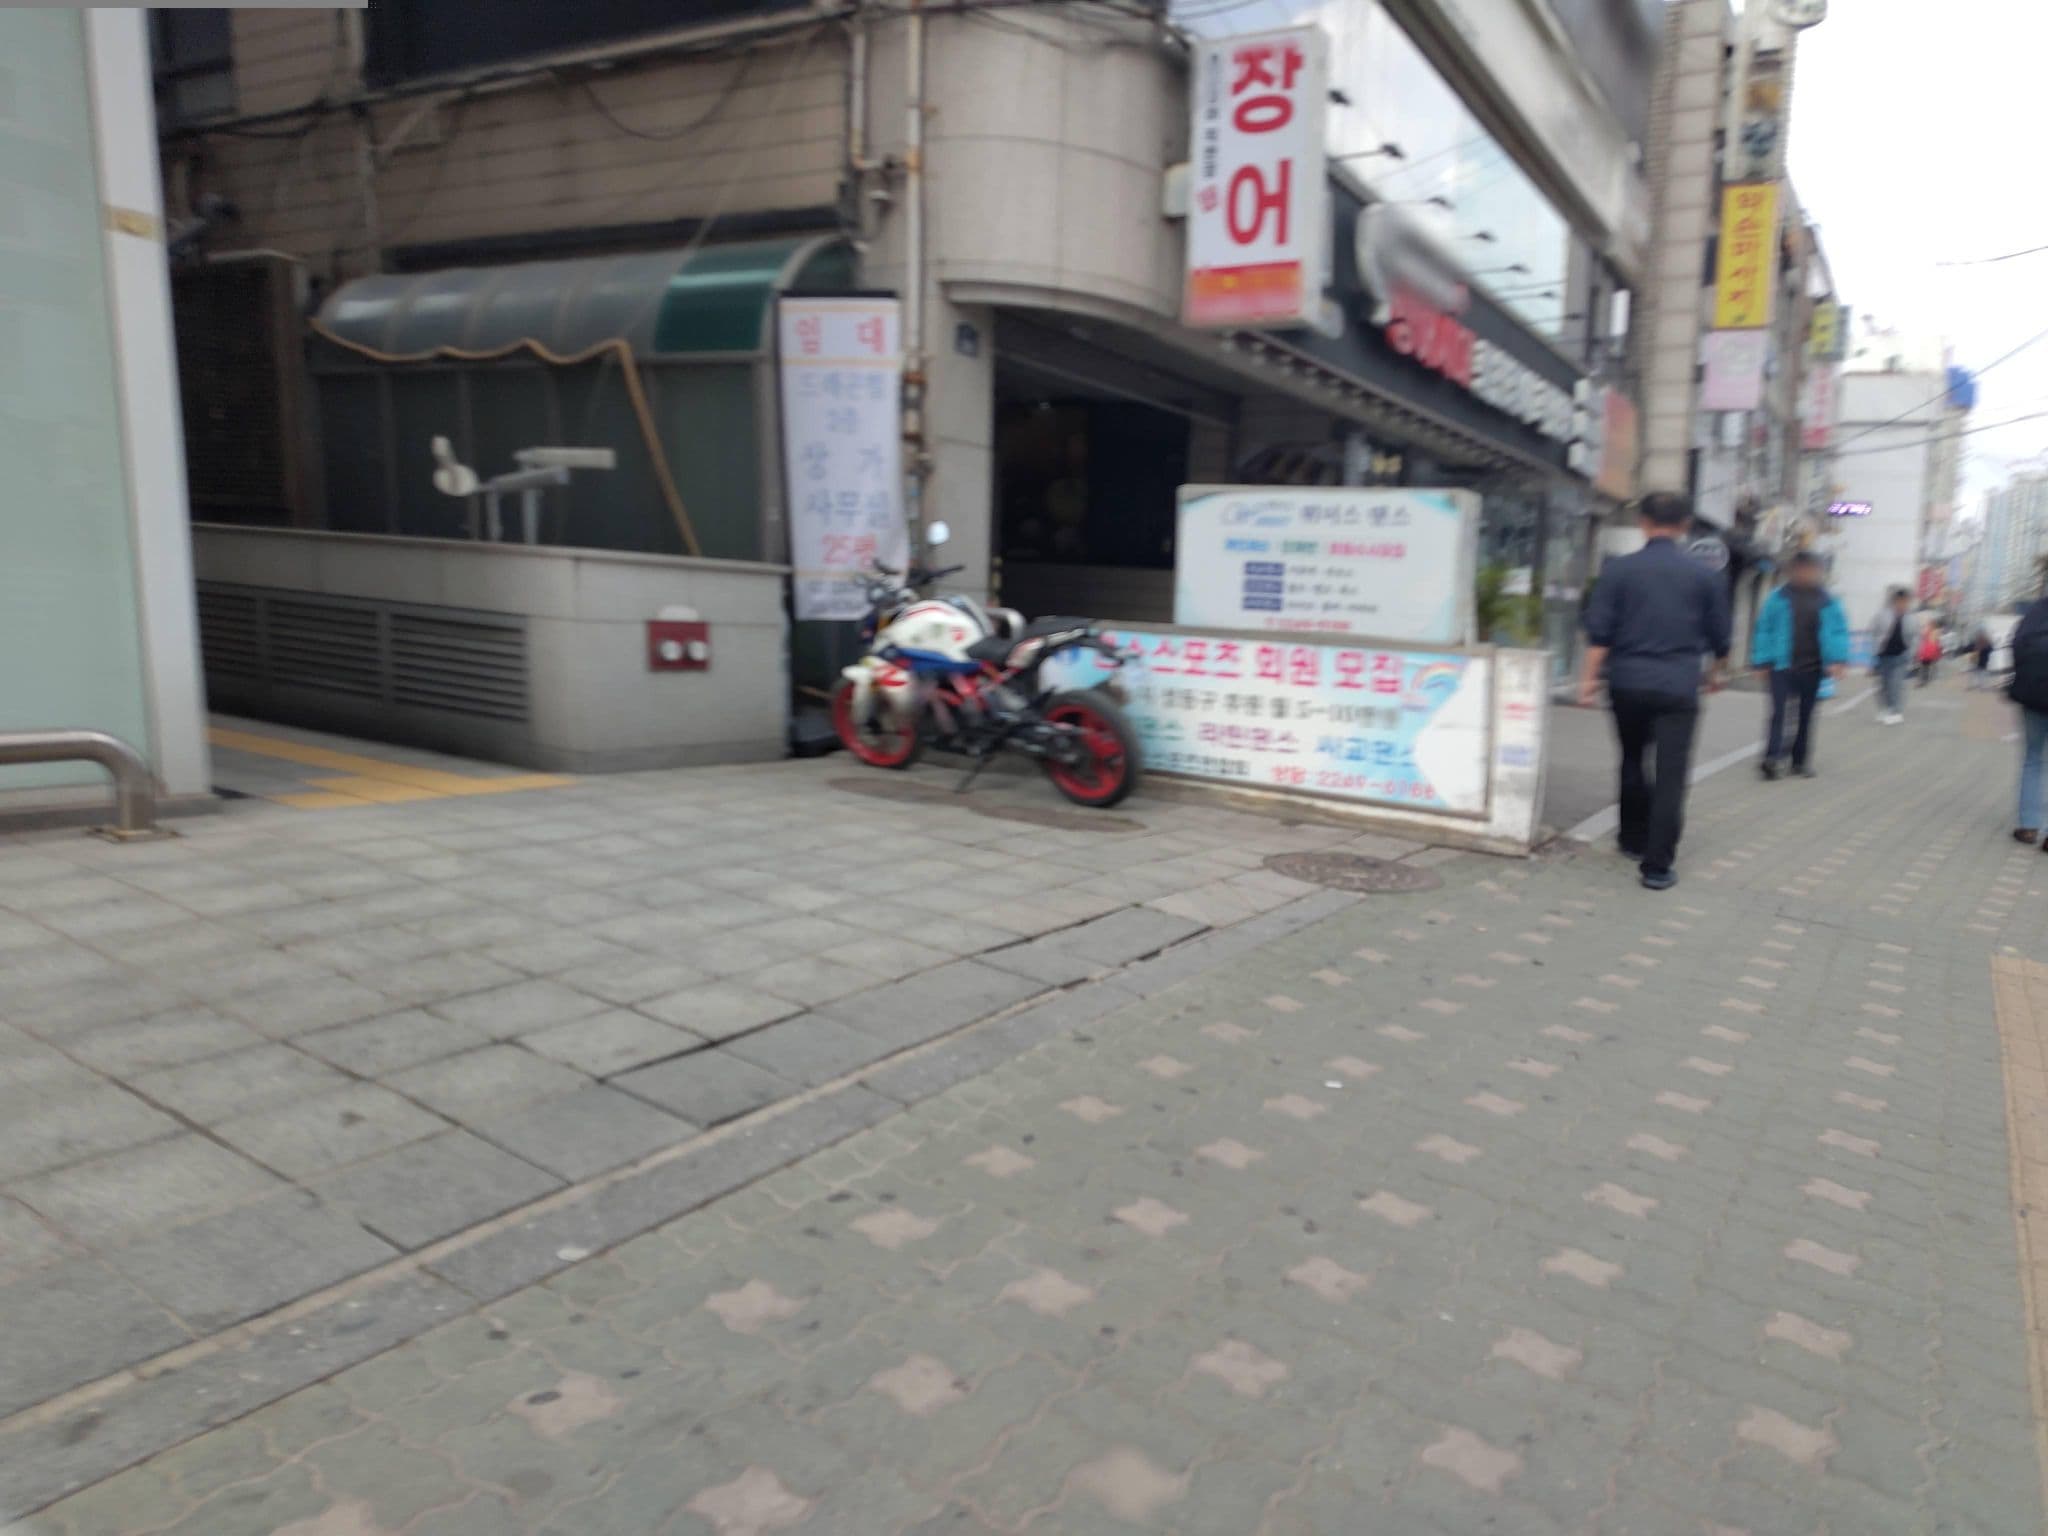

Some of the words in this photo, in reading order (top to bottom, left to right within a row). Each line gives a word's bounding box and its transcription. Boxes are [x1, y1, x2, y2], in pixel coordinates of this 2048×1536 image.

[1226, 45, 1304, 246] 장어
[1255, 646, 1319, 688] 회원
[1333, 650, 1403, 694] 모집
